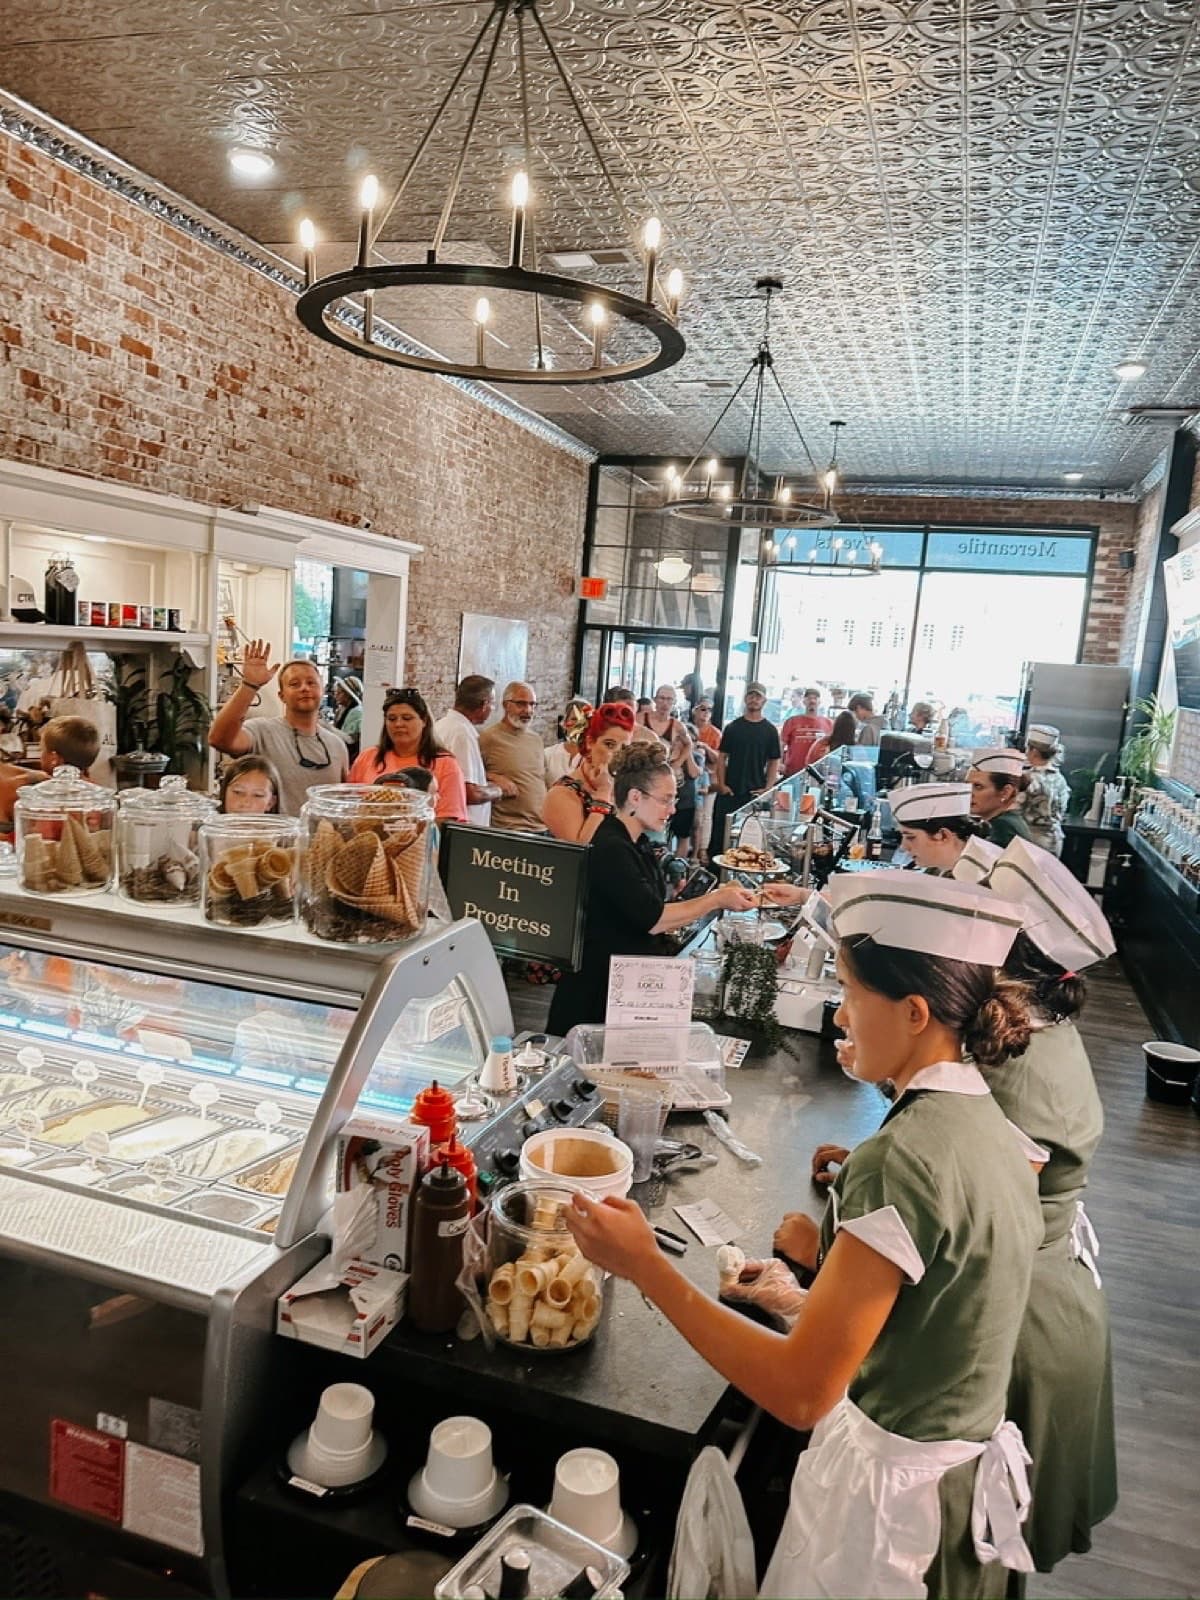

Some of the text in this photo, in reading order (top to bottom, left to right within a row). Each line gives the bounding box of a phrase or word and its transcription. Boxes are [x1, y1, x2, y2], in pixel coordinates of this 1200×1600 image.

[470, 847, 555, 886] Meeting
[498, 880, 520, 902] In
[463, 901, 552, 937] Progress
[385, 1182, 402, 1229] Gloves
